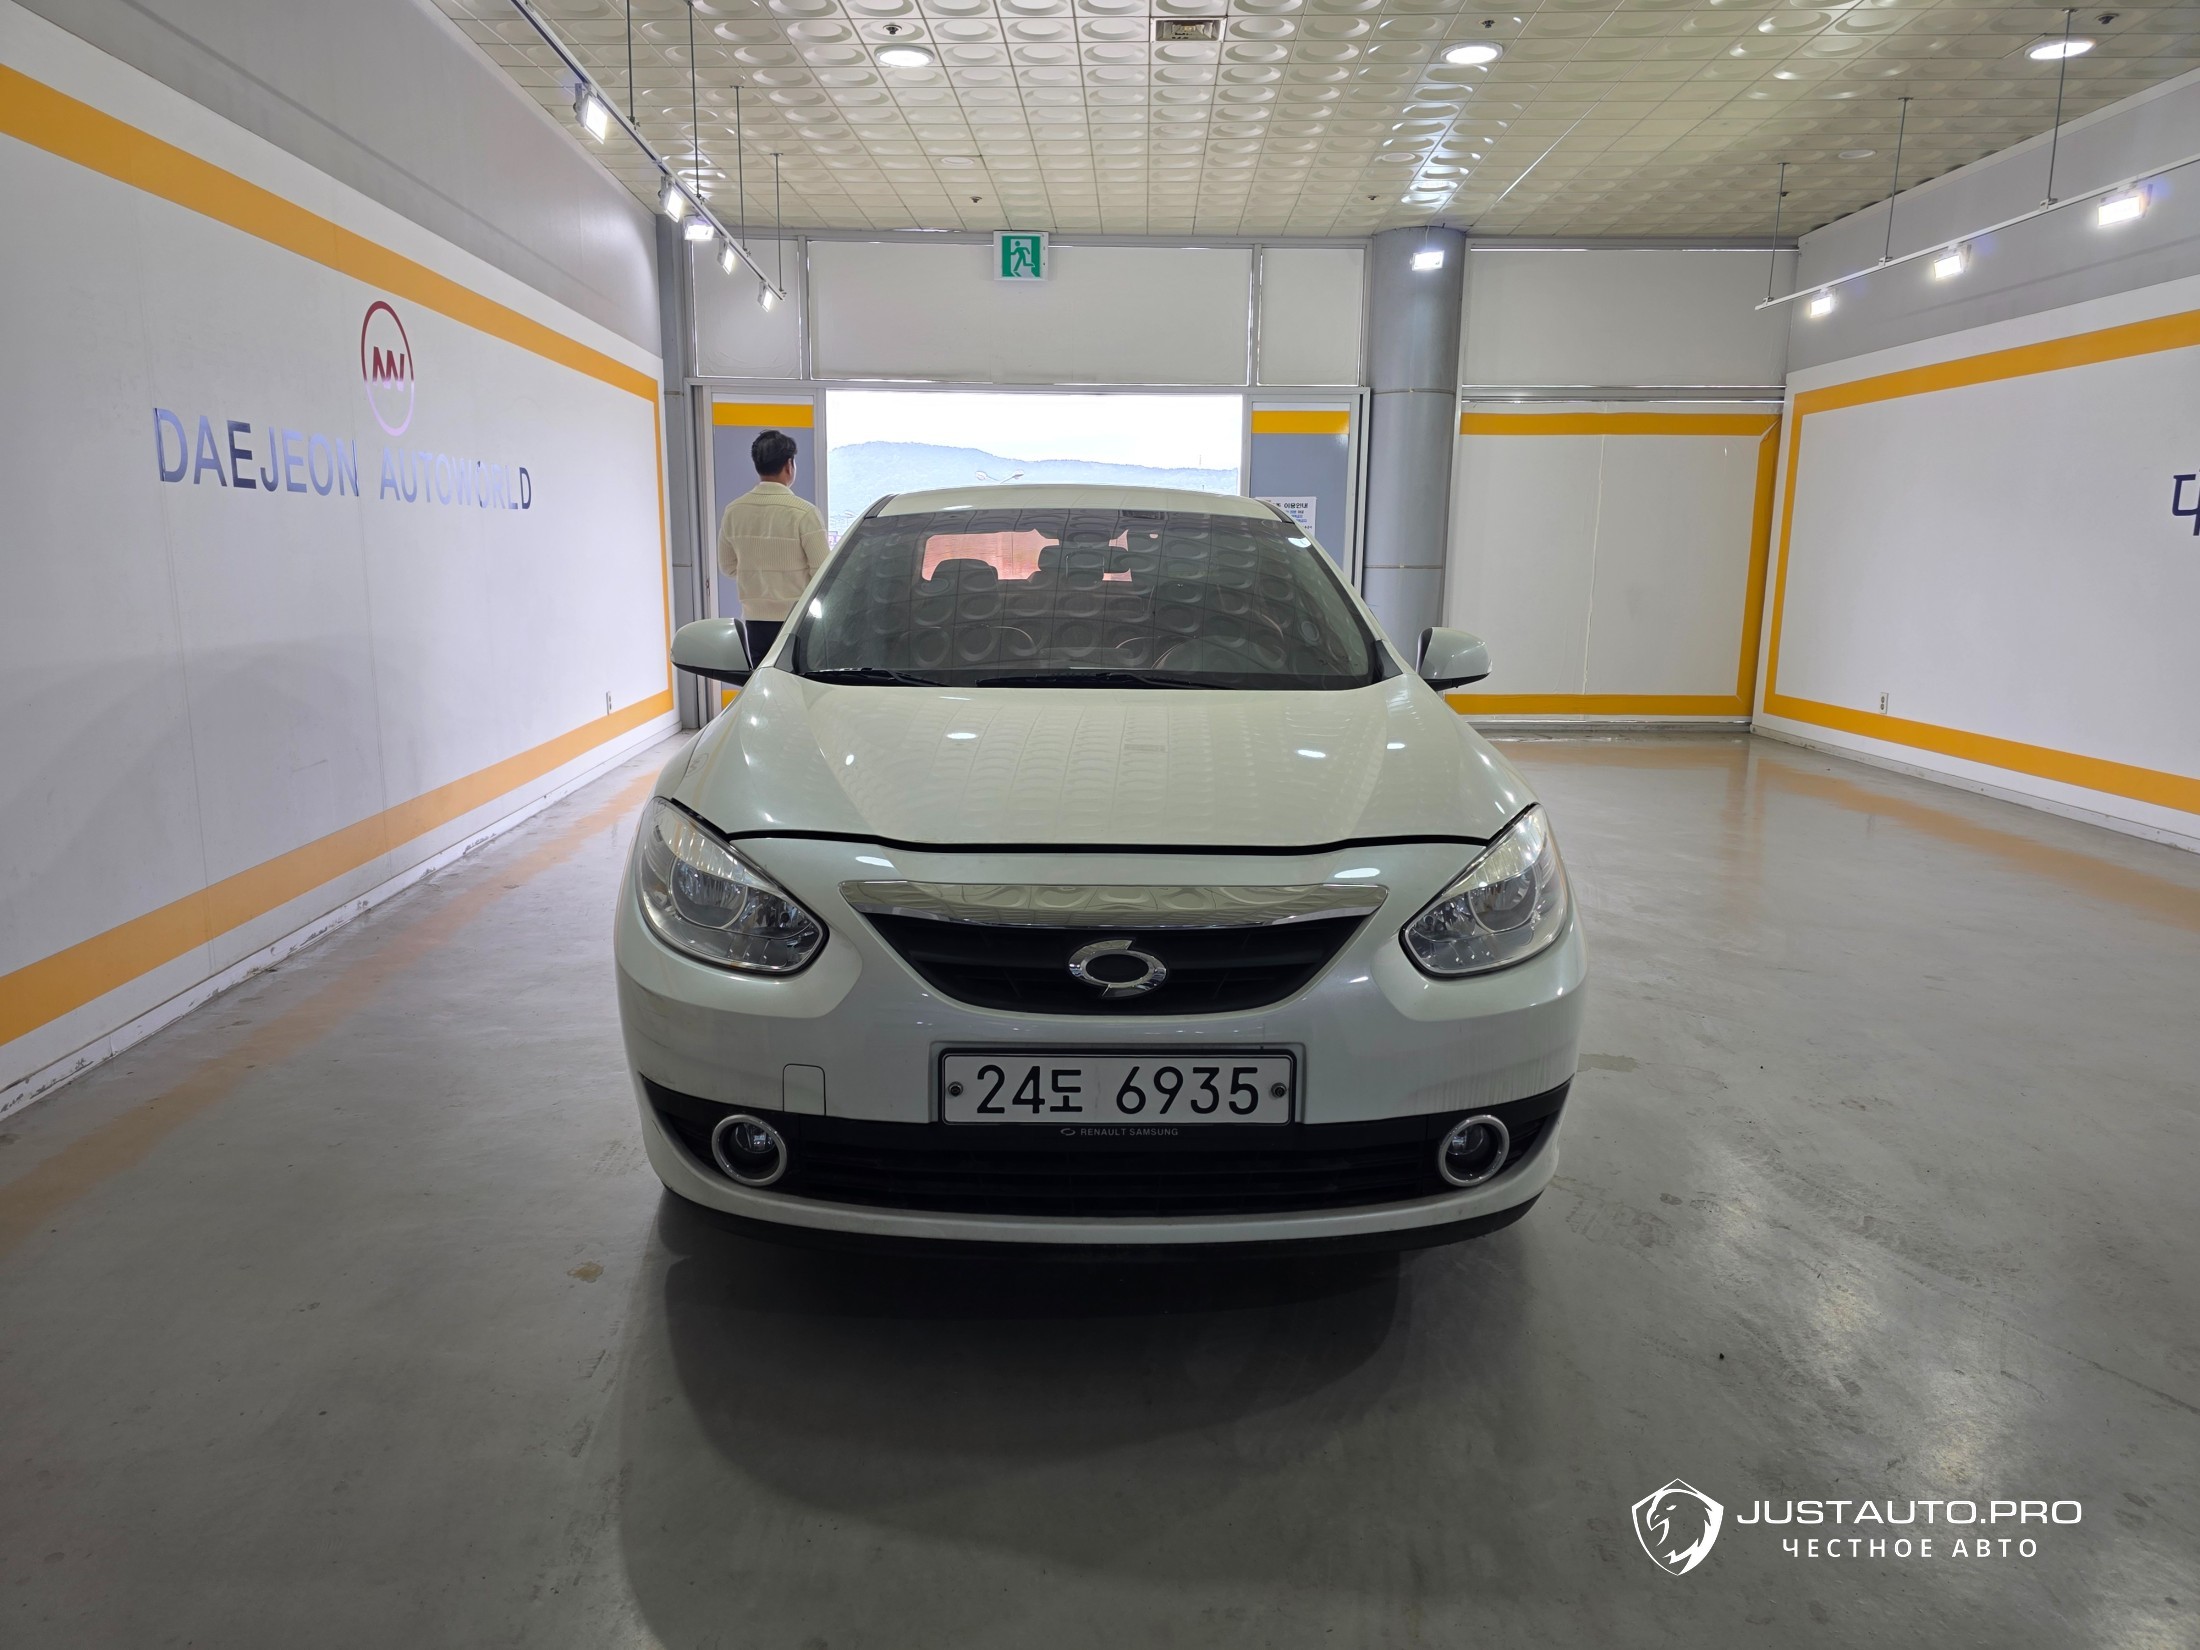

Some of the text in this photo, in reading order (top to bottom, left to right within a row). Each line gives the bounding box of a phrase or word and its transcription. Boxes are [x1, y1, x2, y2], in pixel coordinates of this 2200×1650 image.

[152, 407, 532, 511] DAEJEON AUTOWORLD
[976, 1064, 1260, 1115] 24도 6935
[1080, 1128, 1179, 1136] RENAULT SAMSUNG
